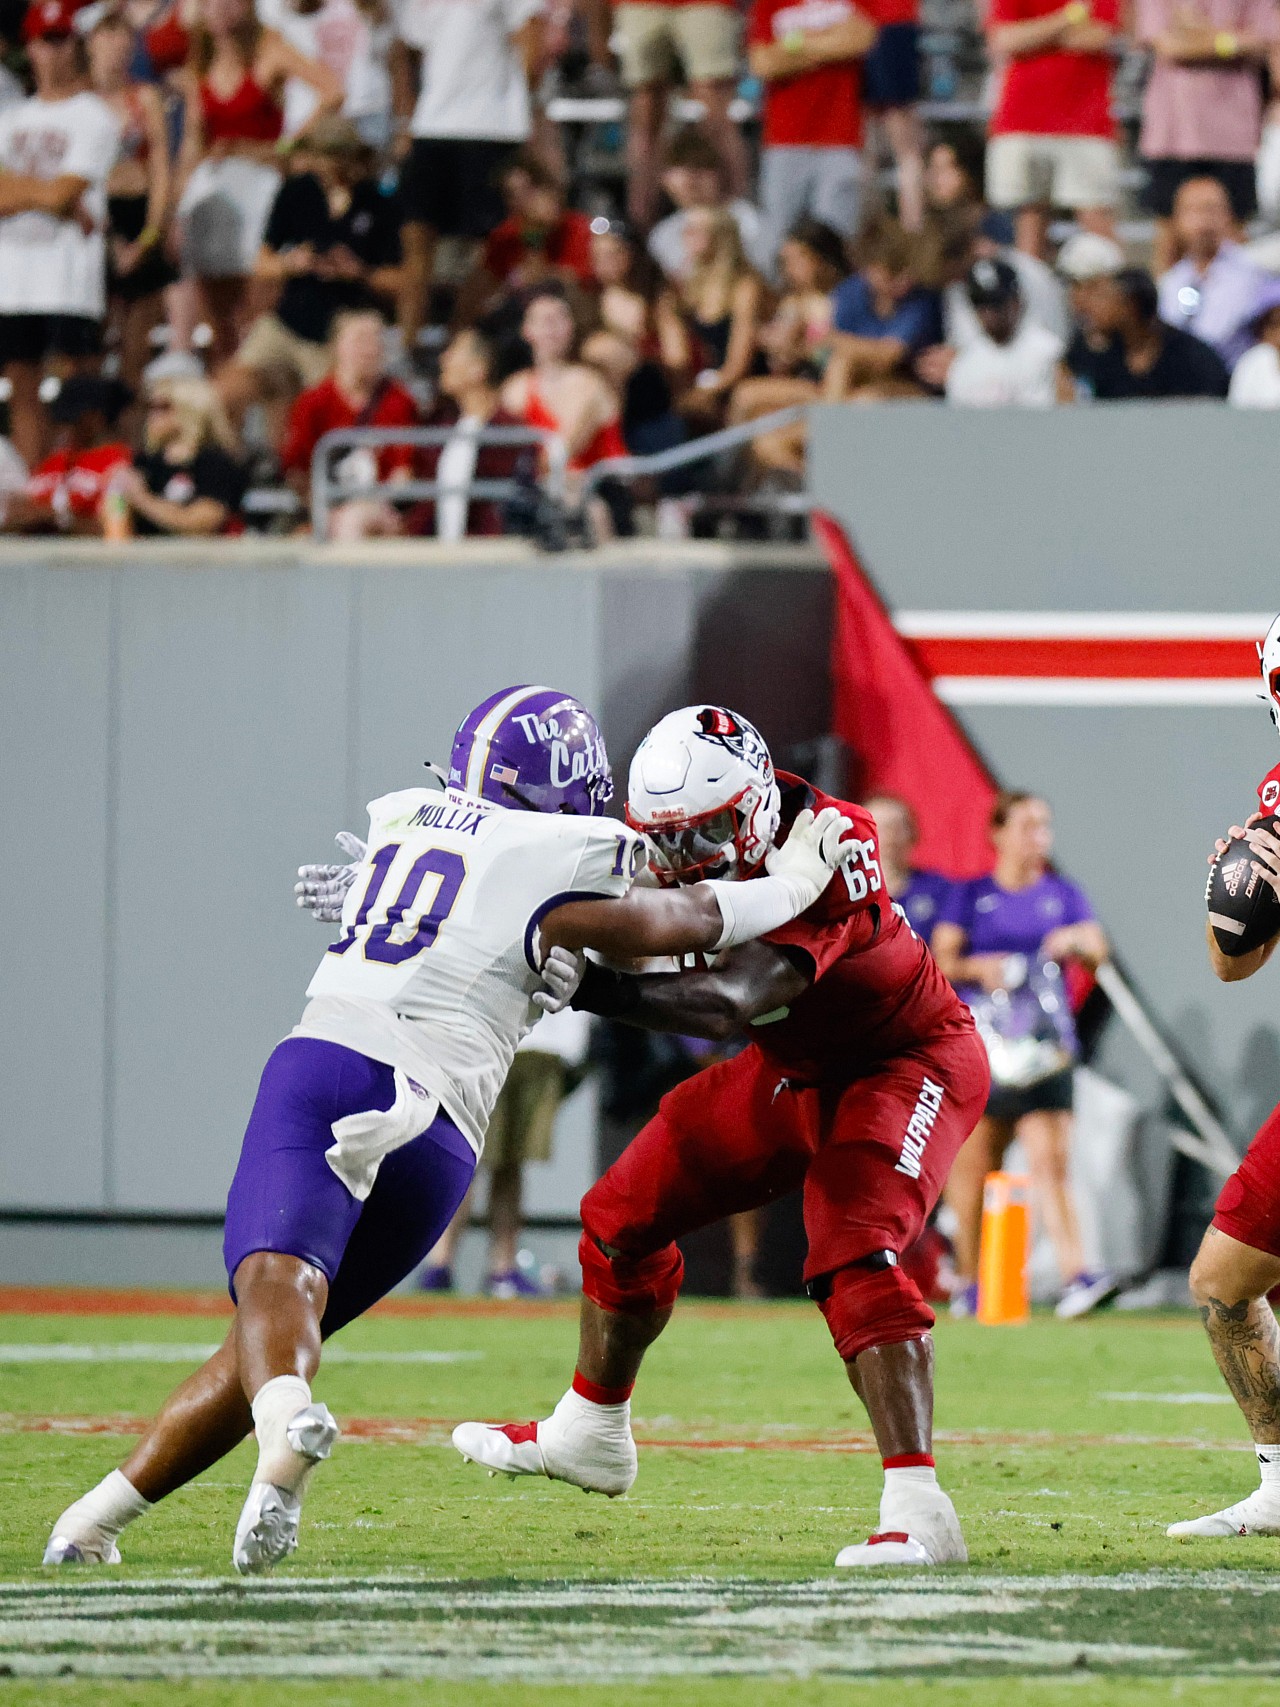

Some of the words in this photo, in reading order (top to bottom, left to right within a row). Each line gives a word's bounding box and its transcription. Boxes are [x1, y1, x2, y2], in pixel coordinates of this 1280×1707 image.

[512, 714, 562, 743] The
[407, 803, 491, 836] MULLIX
[840, 839, 882, 902] 65
[1229, 858, 1248, 897] adidas
[327, 841, 469, 967] 10
